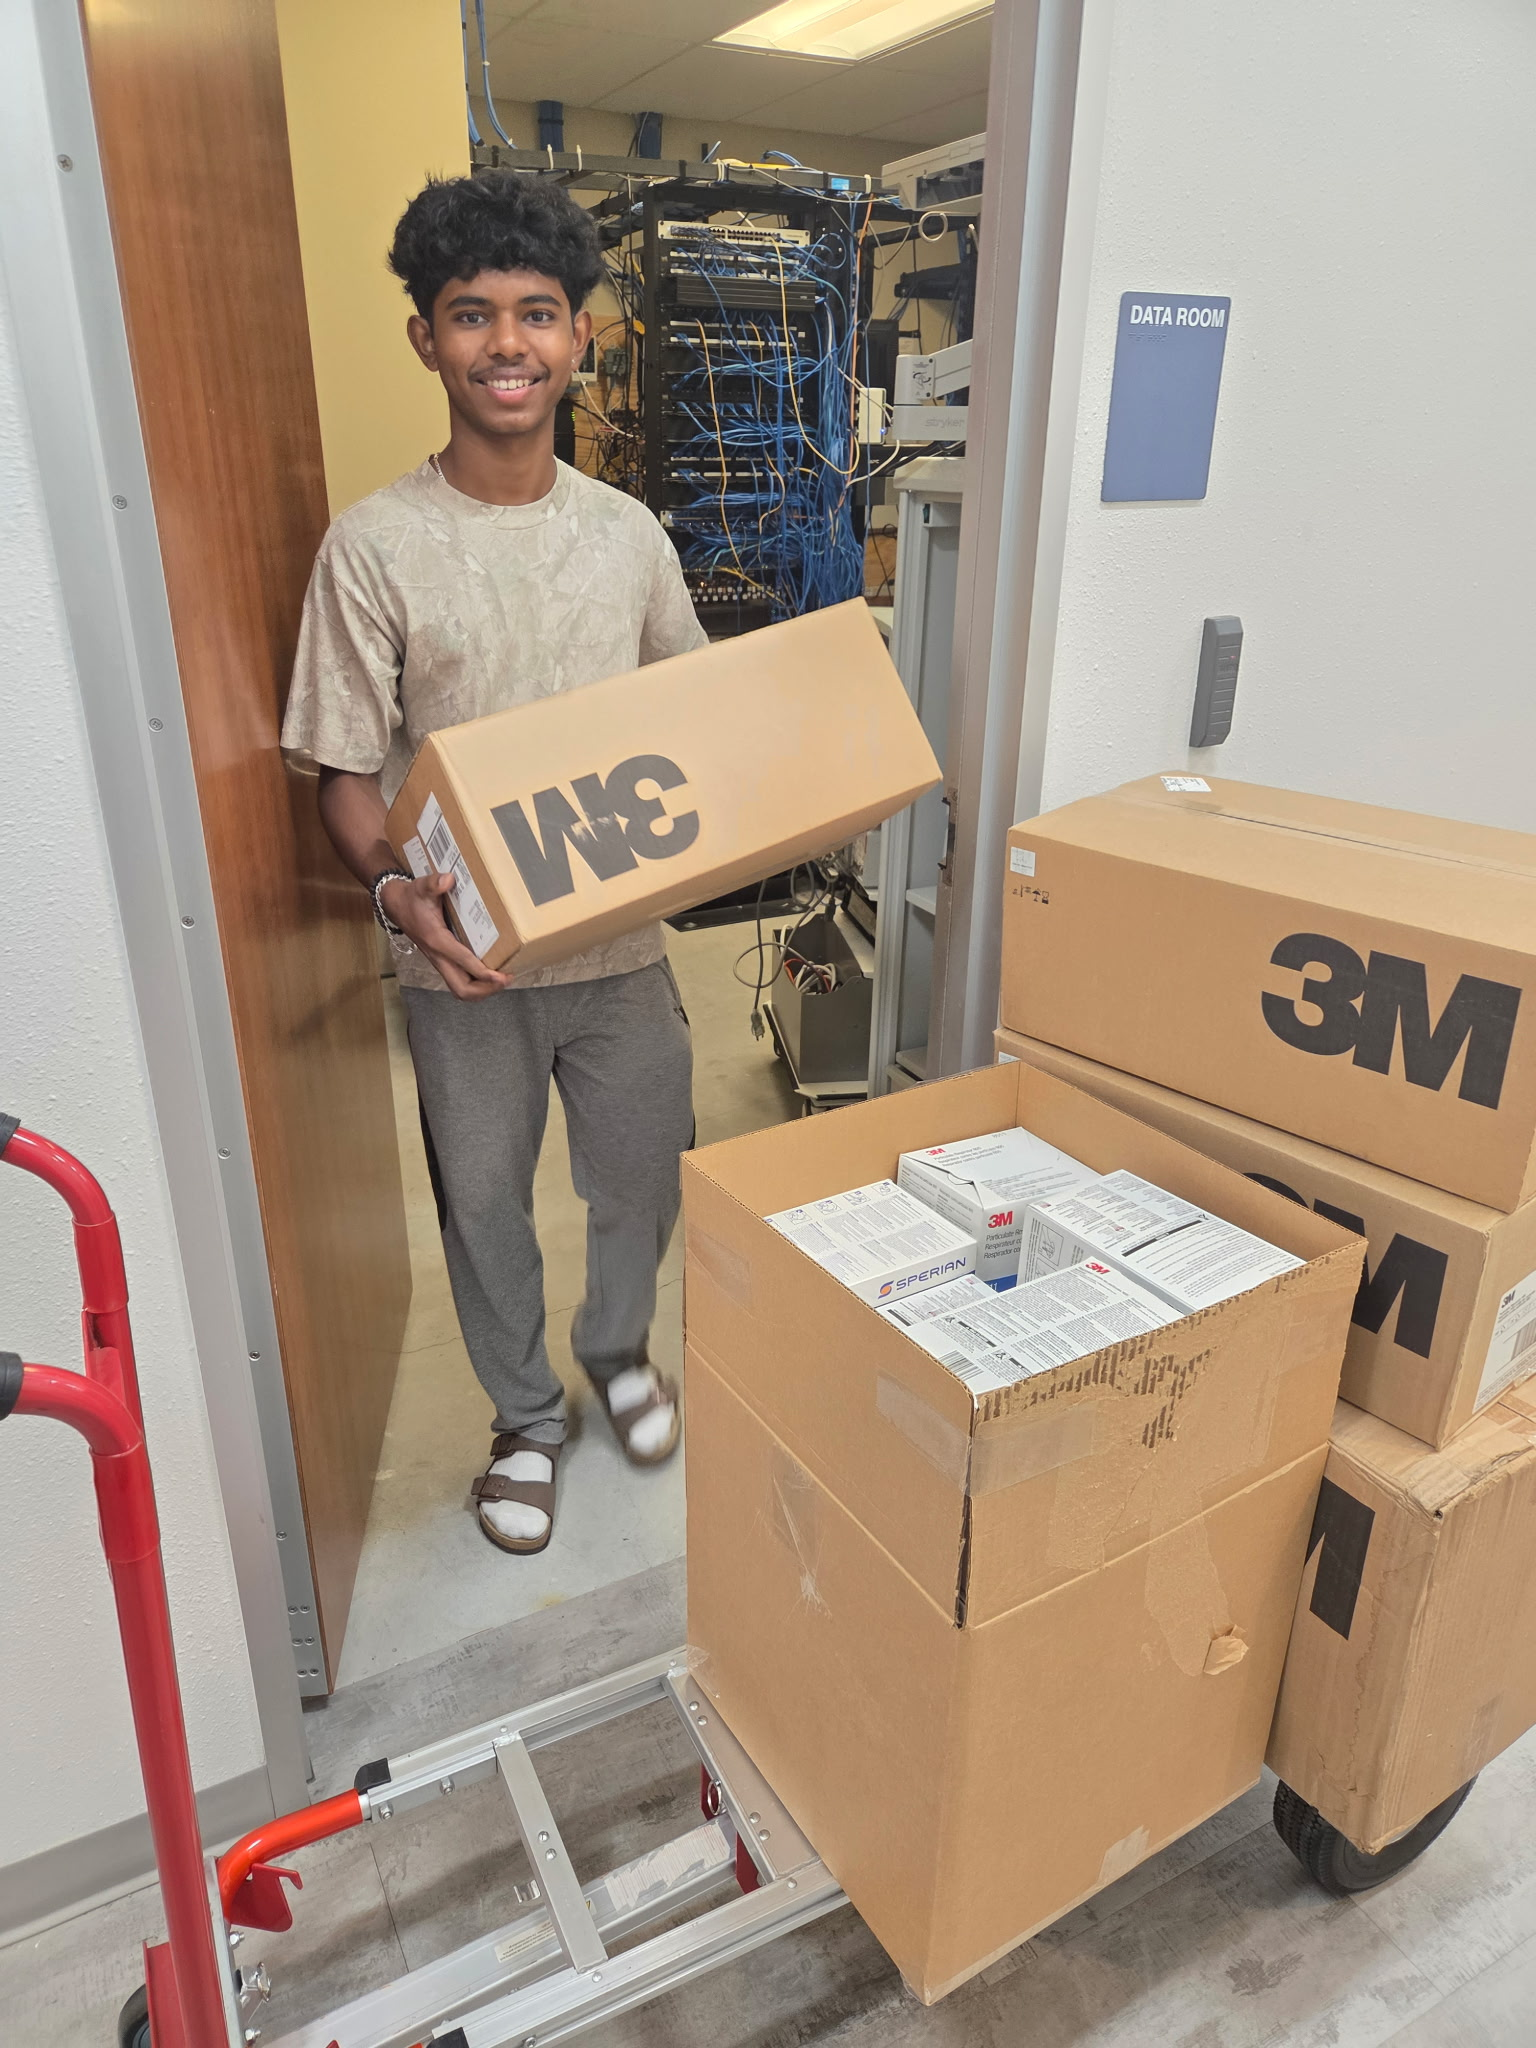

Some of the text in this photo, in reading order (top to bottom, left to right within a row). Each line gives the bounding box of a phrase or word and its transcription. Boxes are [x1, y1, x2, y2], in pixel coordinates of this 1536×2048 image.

[1130, 305, 1226, 328] DATA ROOM
[925, 417, 965, 428] stryker
[490, 754, 700, 907] 3M
[1261, 932, 1523, 1111] 3M
[925, 1148, 946, 1156] 3M
[988, 1210, 1013, 1228] 3M
[986, 1230, 1014, 1241] Particulate
[985, 1239, 1015, 1250] Respirateur
[984, 1248, 1012, 1259] Respirador
[896, 1257, 966, 1291] SPERIAN
[1085, 1262, 1110, 1274] 3M
